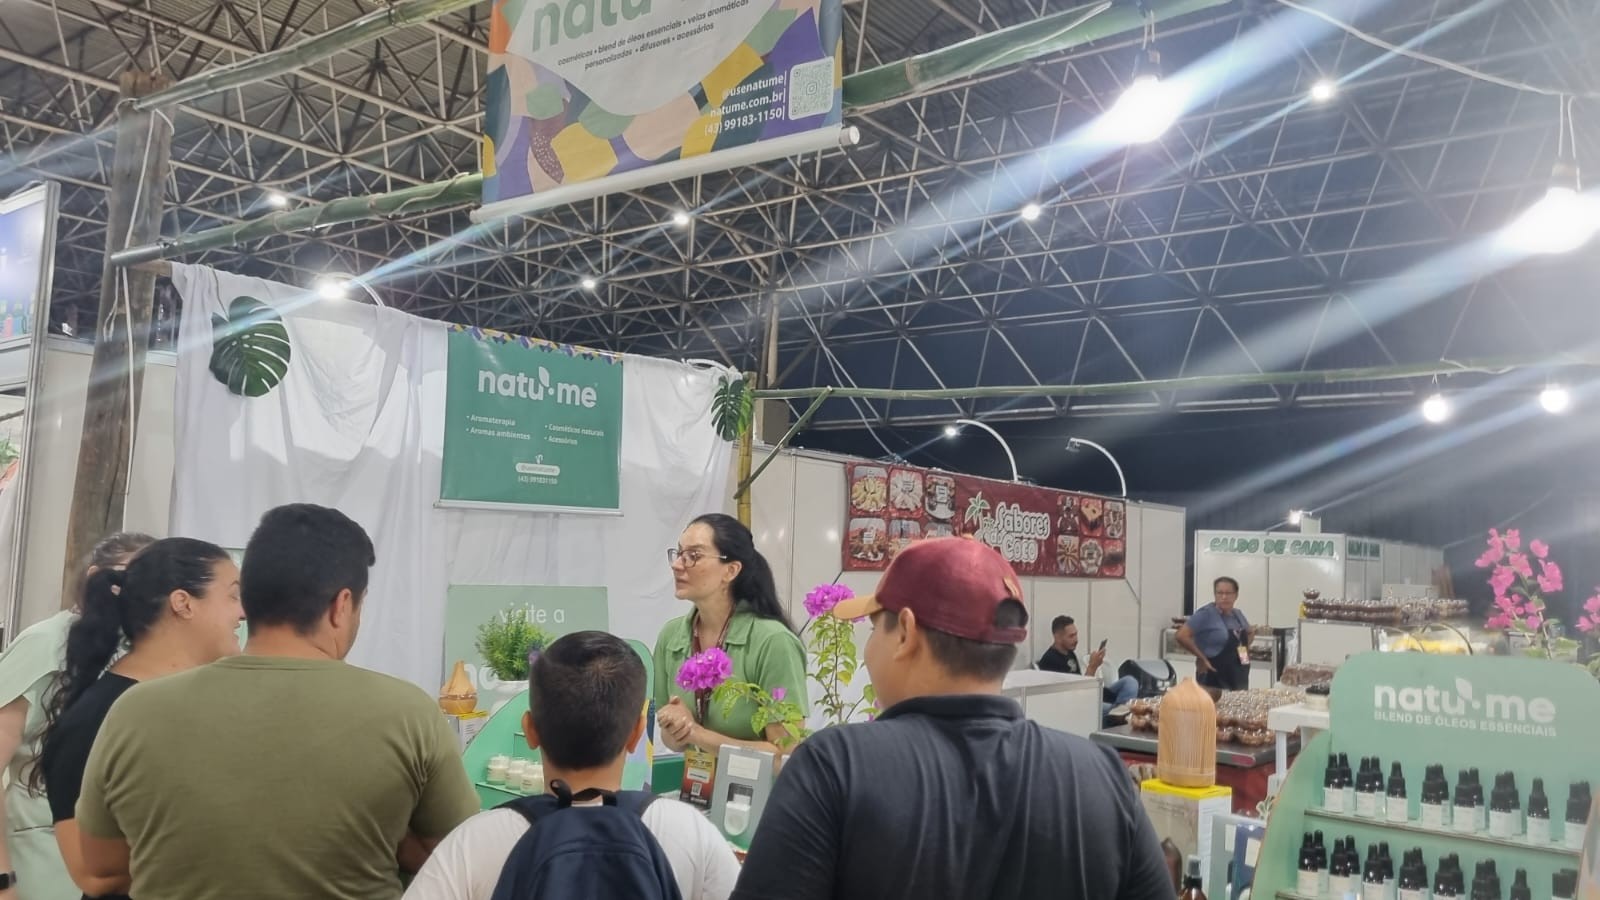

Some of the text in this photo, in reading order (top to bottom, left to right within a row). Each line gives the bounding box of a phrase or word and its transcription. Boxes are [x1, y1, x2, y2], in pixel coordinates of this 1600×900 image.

[598, 40, 617, 54] blend
[617, 38, 626, 48] de
[627, 33, 645, 44] óleos
[646, 20, 681, 38] essenciais
[707, 0, 749, 17] aromáticas
[639, 36, 671, 54] difusores
[677, 22, 714, 41] acessórios
[710, 91, 783, 118] natume.com.br
[724, 107, 782, 131] 99183-1150
[470, 414, 516, 427] Aromaterapia
[496, 430, 531, 441] ambientes
[997, 502, 1050, 539] Sabores
[1001, 531, 1038, 562] Coco
[1209, 537, 1259, 554] CALDO
[1263, 538, 1287, 555] DE
[553, 608, 565, 624] a
[1373, 710, 1557, 738] BLEND DE ÓLEOS ESSENCIAIS
